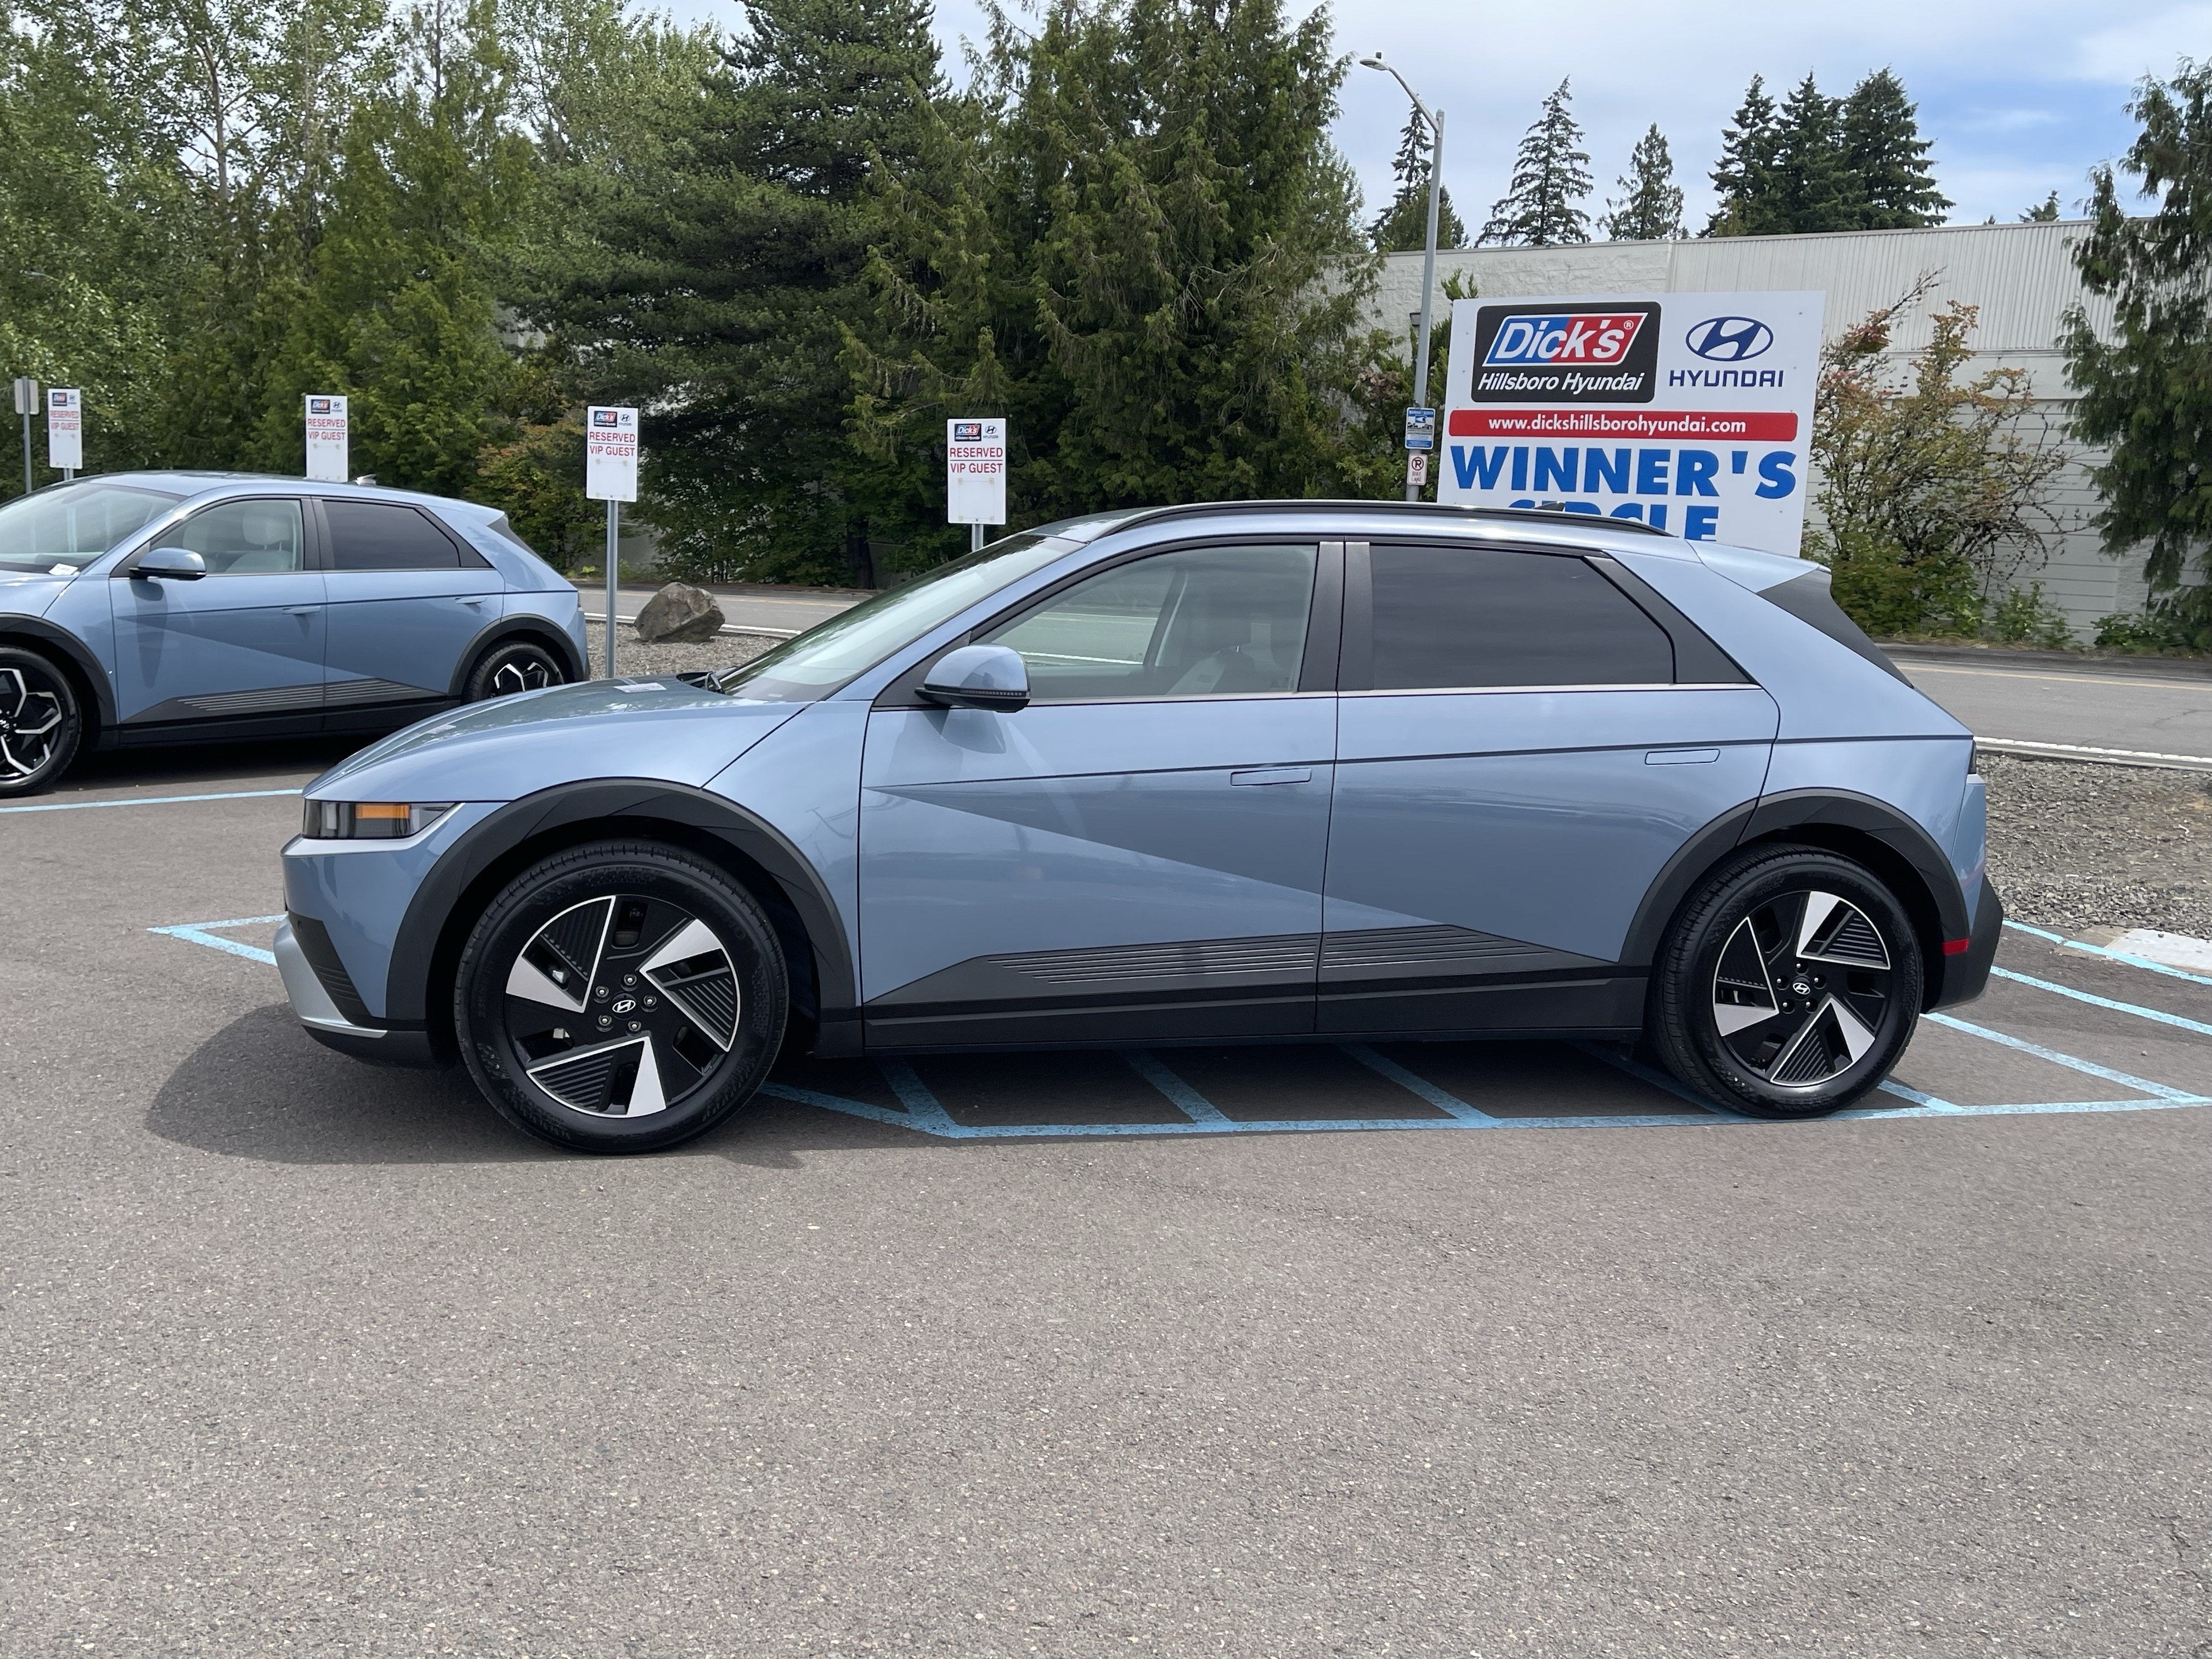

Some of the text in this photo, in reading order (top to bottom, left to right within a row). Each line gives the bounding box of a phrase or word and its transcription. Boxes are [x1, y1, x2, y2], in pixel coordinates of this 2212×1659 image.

[1477, 372, 1645, 395] Hillsboro Hyundai
[1669, 369, 1784, 387] HYUNDAI
[308, 419, 346, 427] RESERVED
[1488, 414, 1747, 436] www.dickshillsborohyundai.com
[308, 431, 346, 441] VIP GUEST
[589, 431, 635, 443] RESERVED
[590, 445, 635, 456] VIP GUEST
[950, 447, 1003, 458] RESERVED
[950, 463, 1003, 473] VIP GUEST
[1450, 445, 1797, 499] WINNER'S
